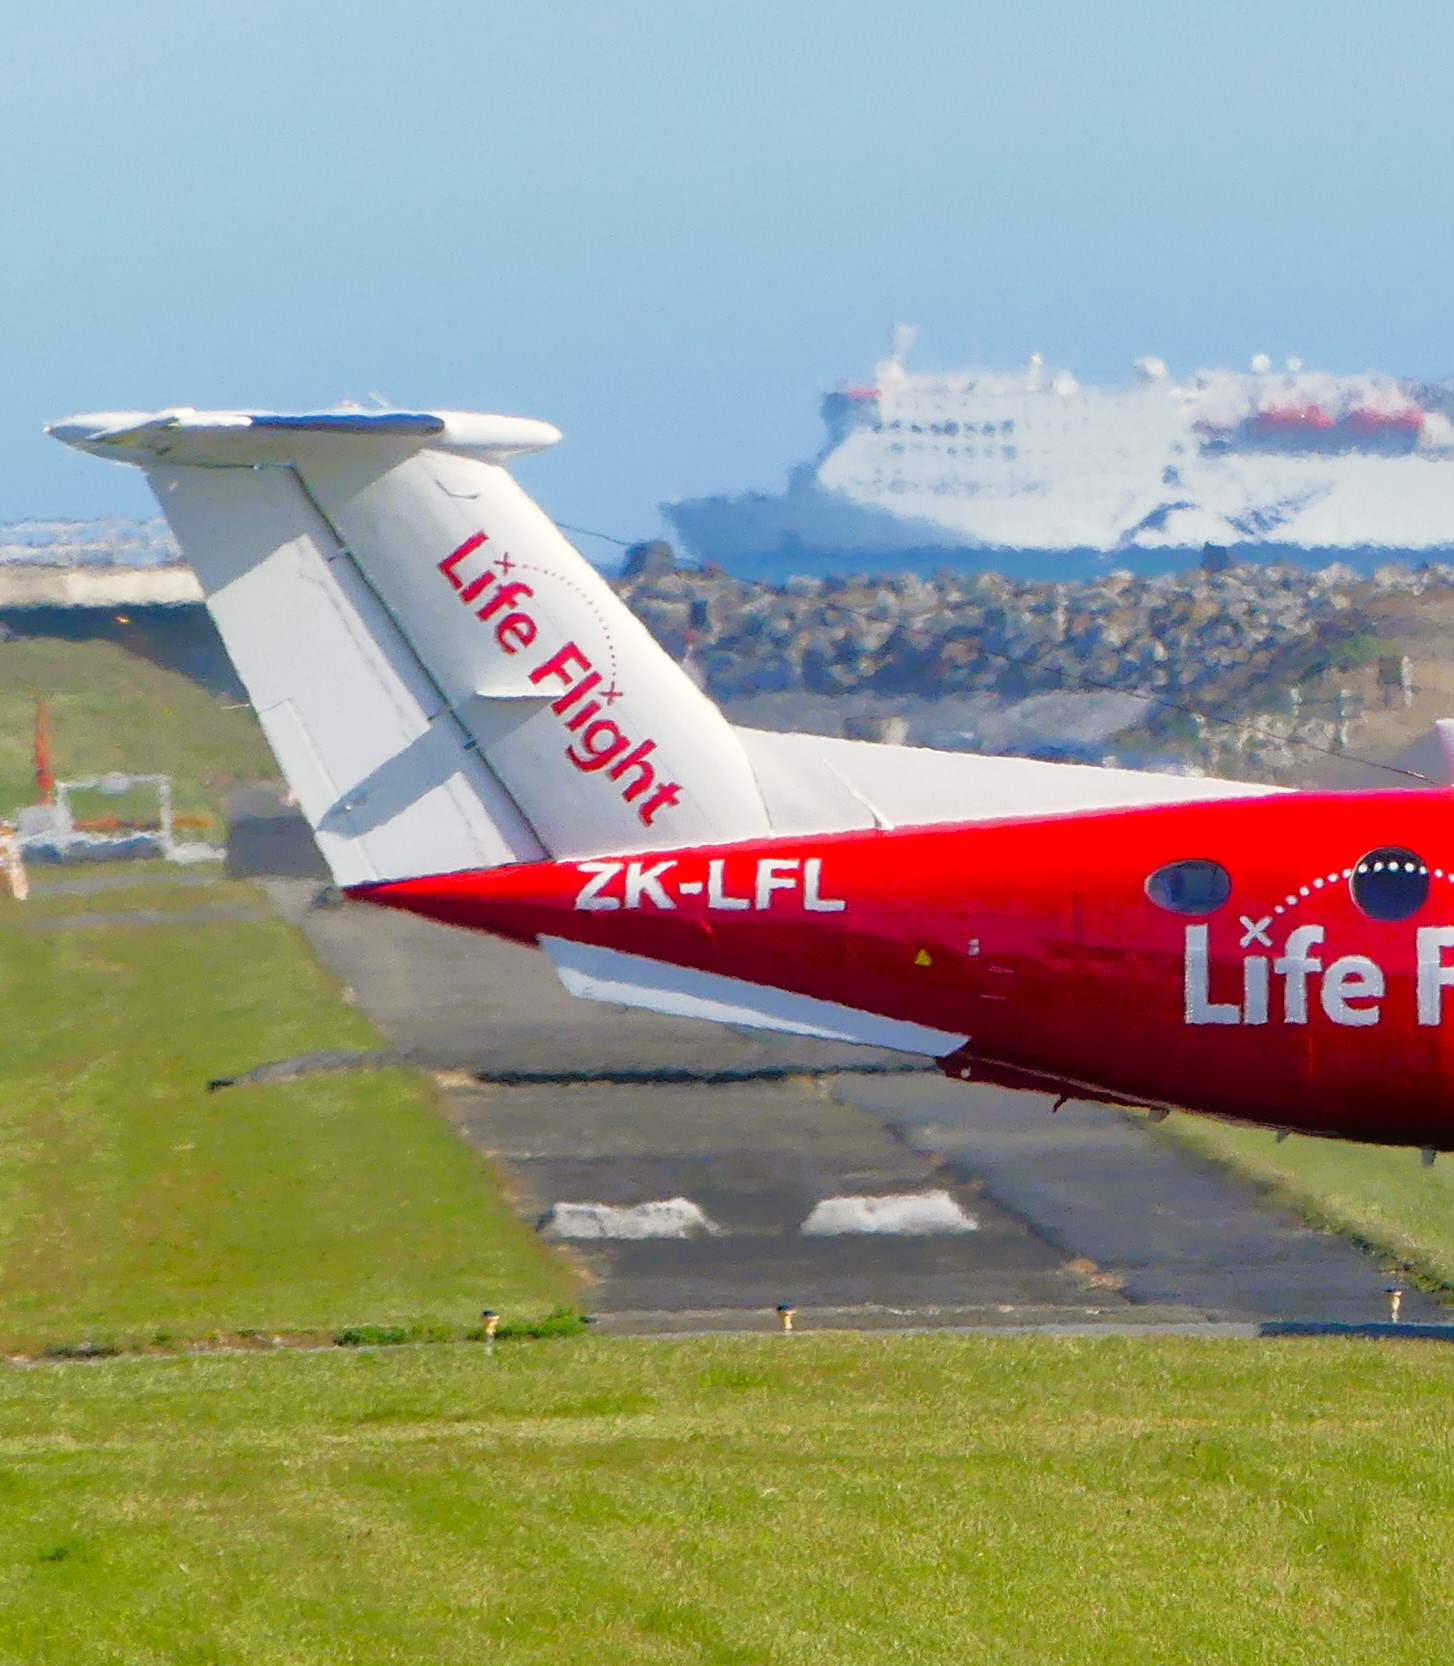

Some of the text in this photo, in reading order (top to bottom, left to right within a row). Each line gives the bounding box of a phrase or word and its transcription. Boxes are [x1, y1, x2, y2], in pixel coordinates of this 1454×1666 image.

[437, 530, 683, 827] Life Flight
[574, 858, 846, 912] ZK-LFL
[1183, 915, 1386, 1026] Life
